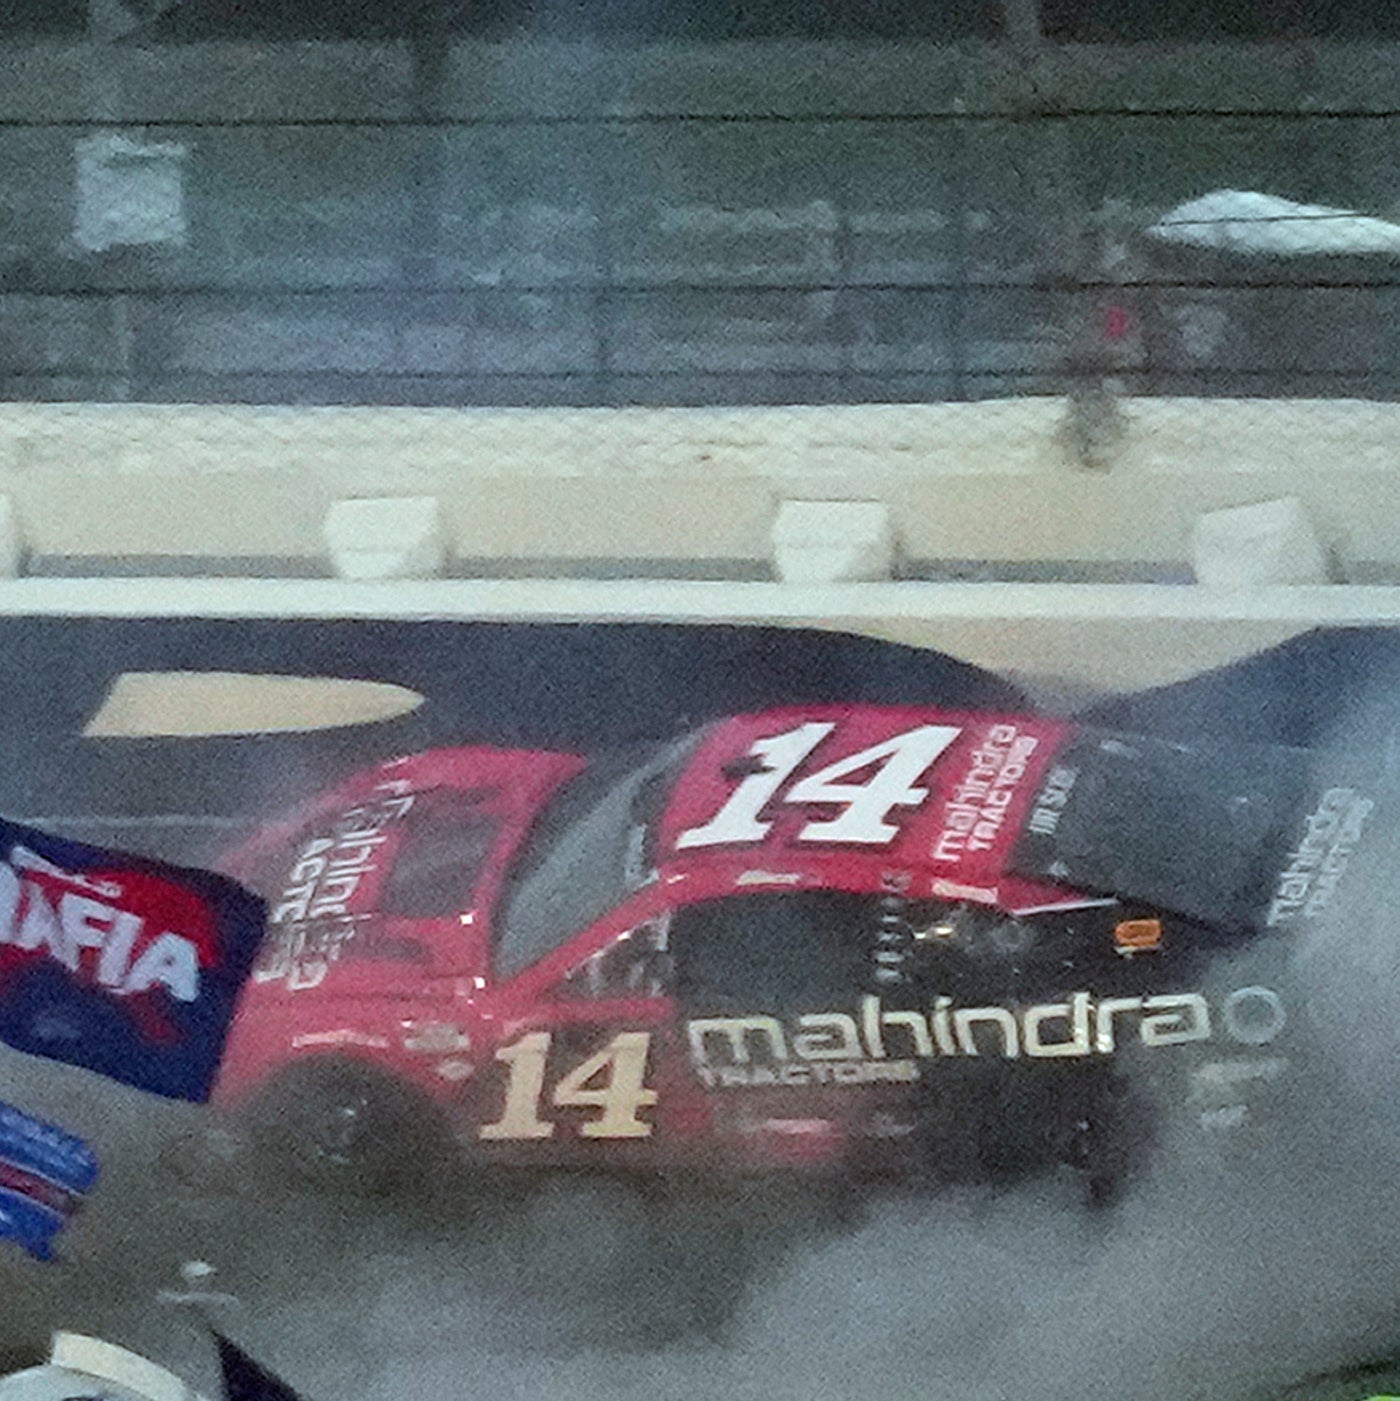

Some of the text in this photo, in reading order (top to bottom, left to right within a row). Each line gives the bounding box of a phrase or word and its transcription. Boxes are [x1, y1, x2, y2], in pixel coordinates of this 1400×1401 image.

[673, 722, 962, 850] 14
[931, 723, 1017, 861] mahindra
[479, 1029, 658, 1140] 14
[689, 992, 1212, 1061] mahindra
